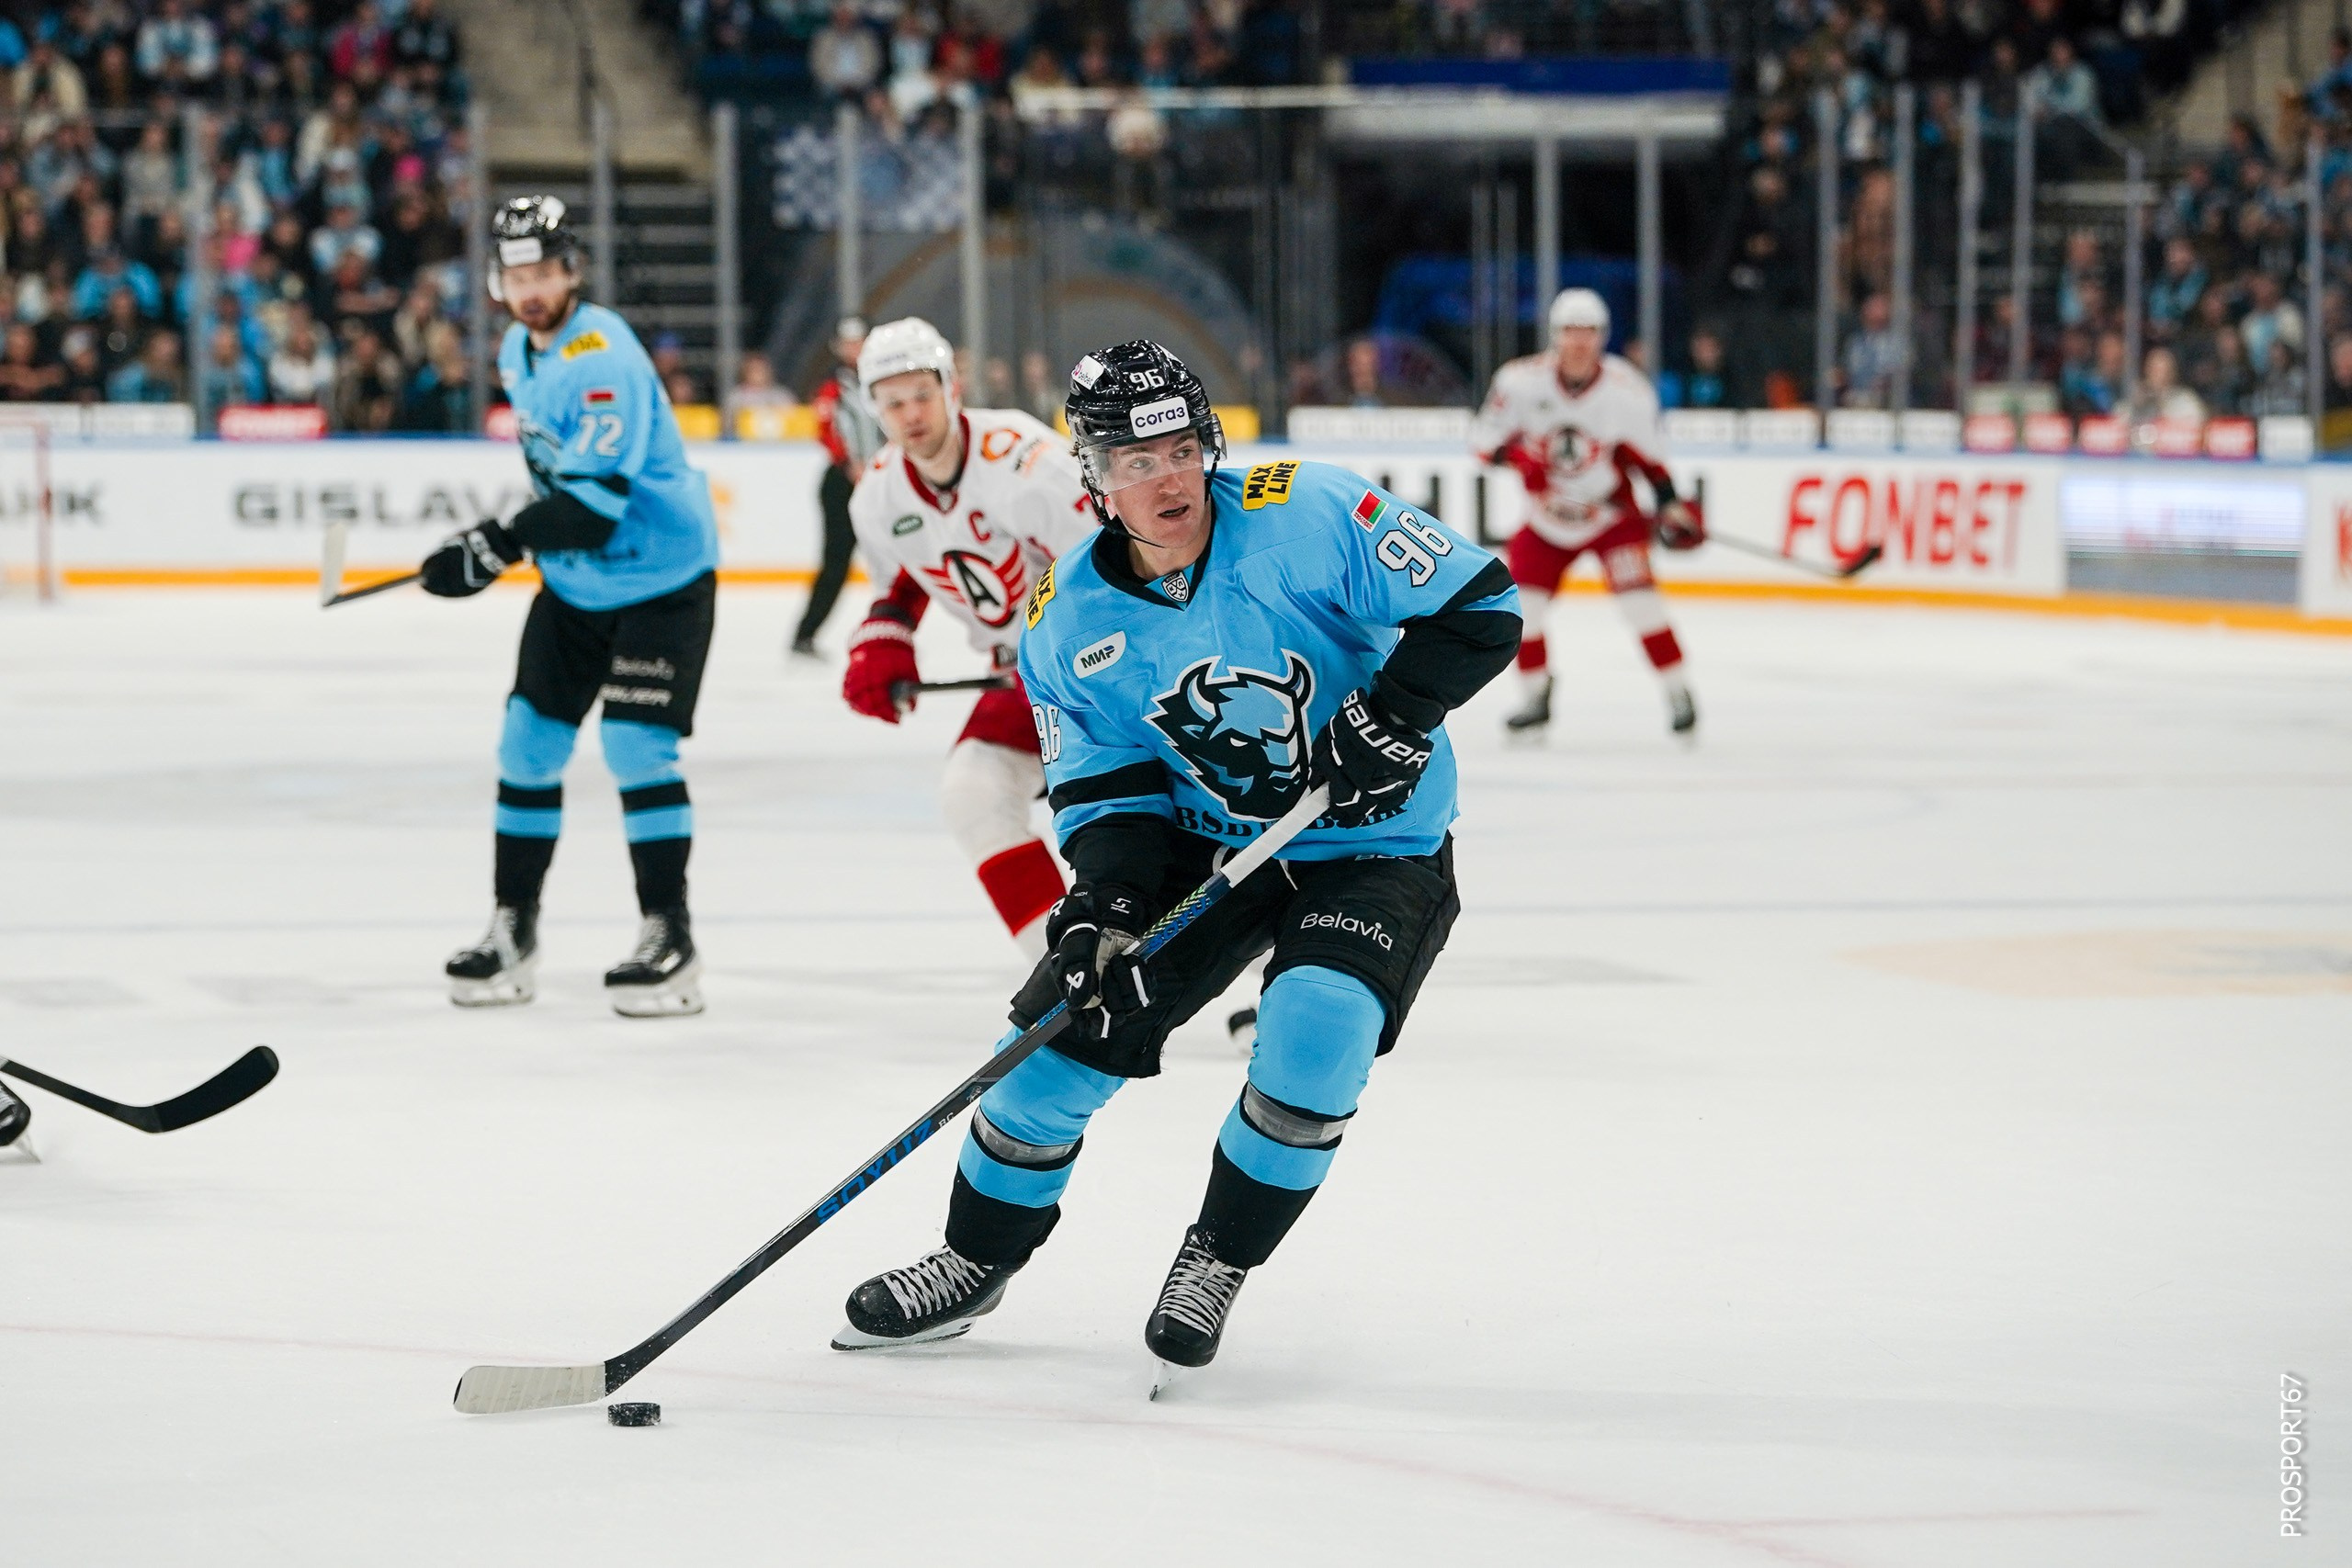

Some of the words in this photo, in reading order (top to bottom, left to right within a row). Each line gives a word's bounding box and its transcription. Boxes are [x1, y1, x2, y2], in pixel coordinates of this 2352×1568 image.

[1128, 368, 1165, 392] 96
[1246, 466, 1274, 500] MAX
[1267, 462, 1297, 495] LINE
[234, 482, 531, 527] GISLAV
[1780, 476, 2028, 569] FONBET
[1375, 510, 1453, 588] 96
[1080, 645, 1115, 669] МИР
[1032, 704, 1062, 765] 96
[1299, 911, 1394, 952] Belavia
